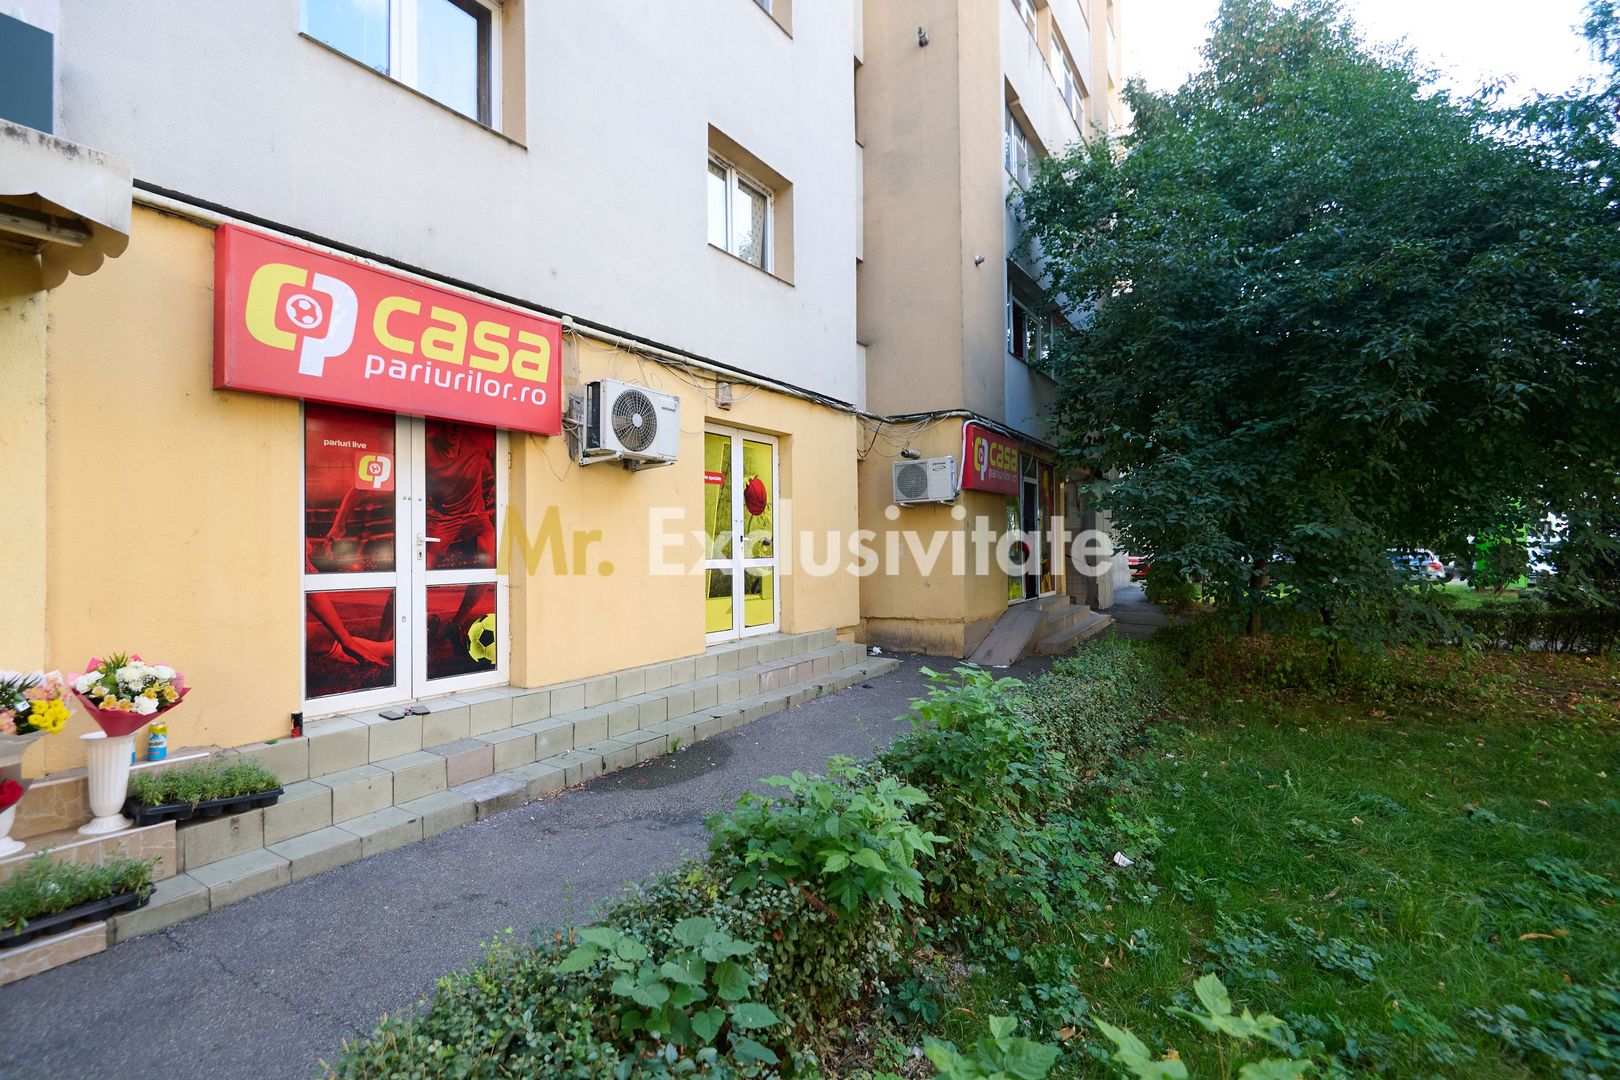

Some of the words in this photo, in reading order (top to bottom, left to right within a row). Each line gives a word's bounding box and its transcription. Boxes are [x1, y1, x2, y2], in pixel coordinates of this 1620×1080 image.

[373, 296, 551, 384] casa
[364, 354, 547, 406] pariurilor.ro
[323, 439, 351, 448] pariuri
[352, 441, 367, 449] live
[990, 442, 1018, 472] casa
